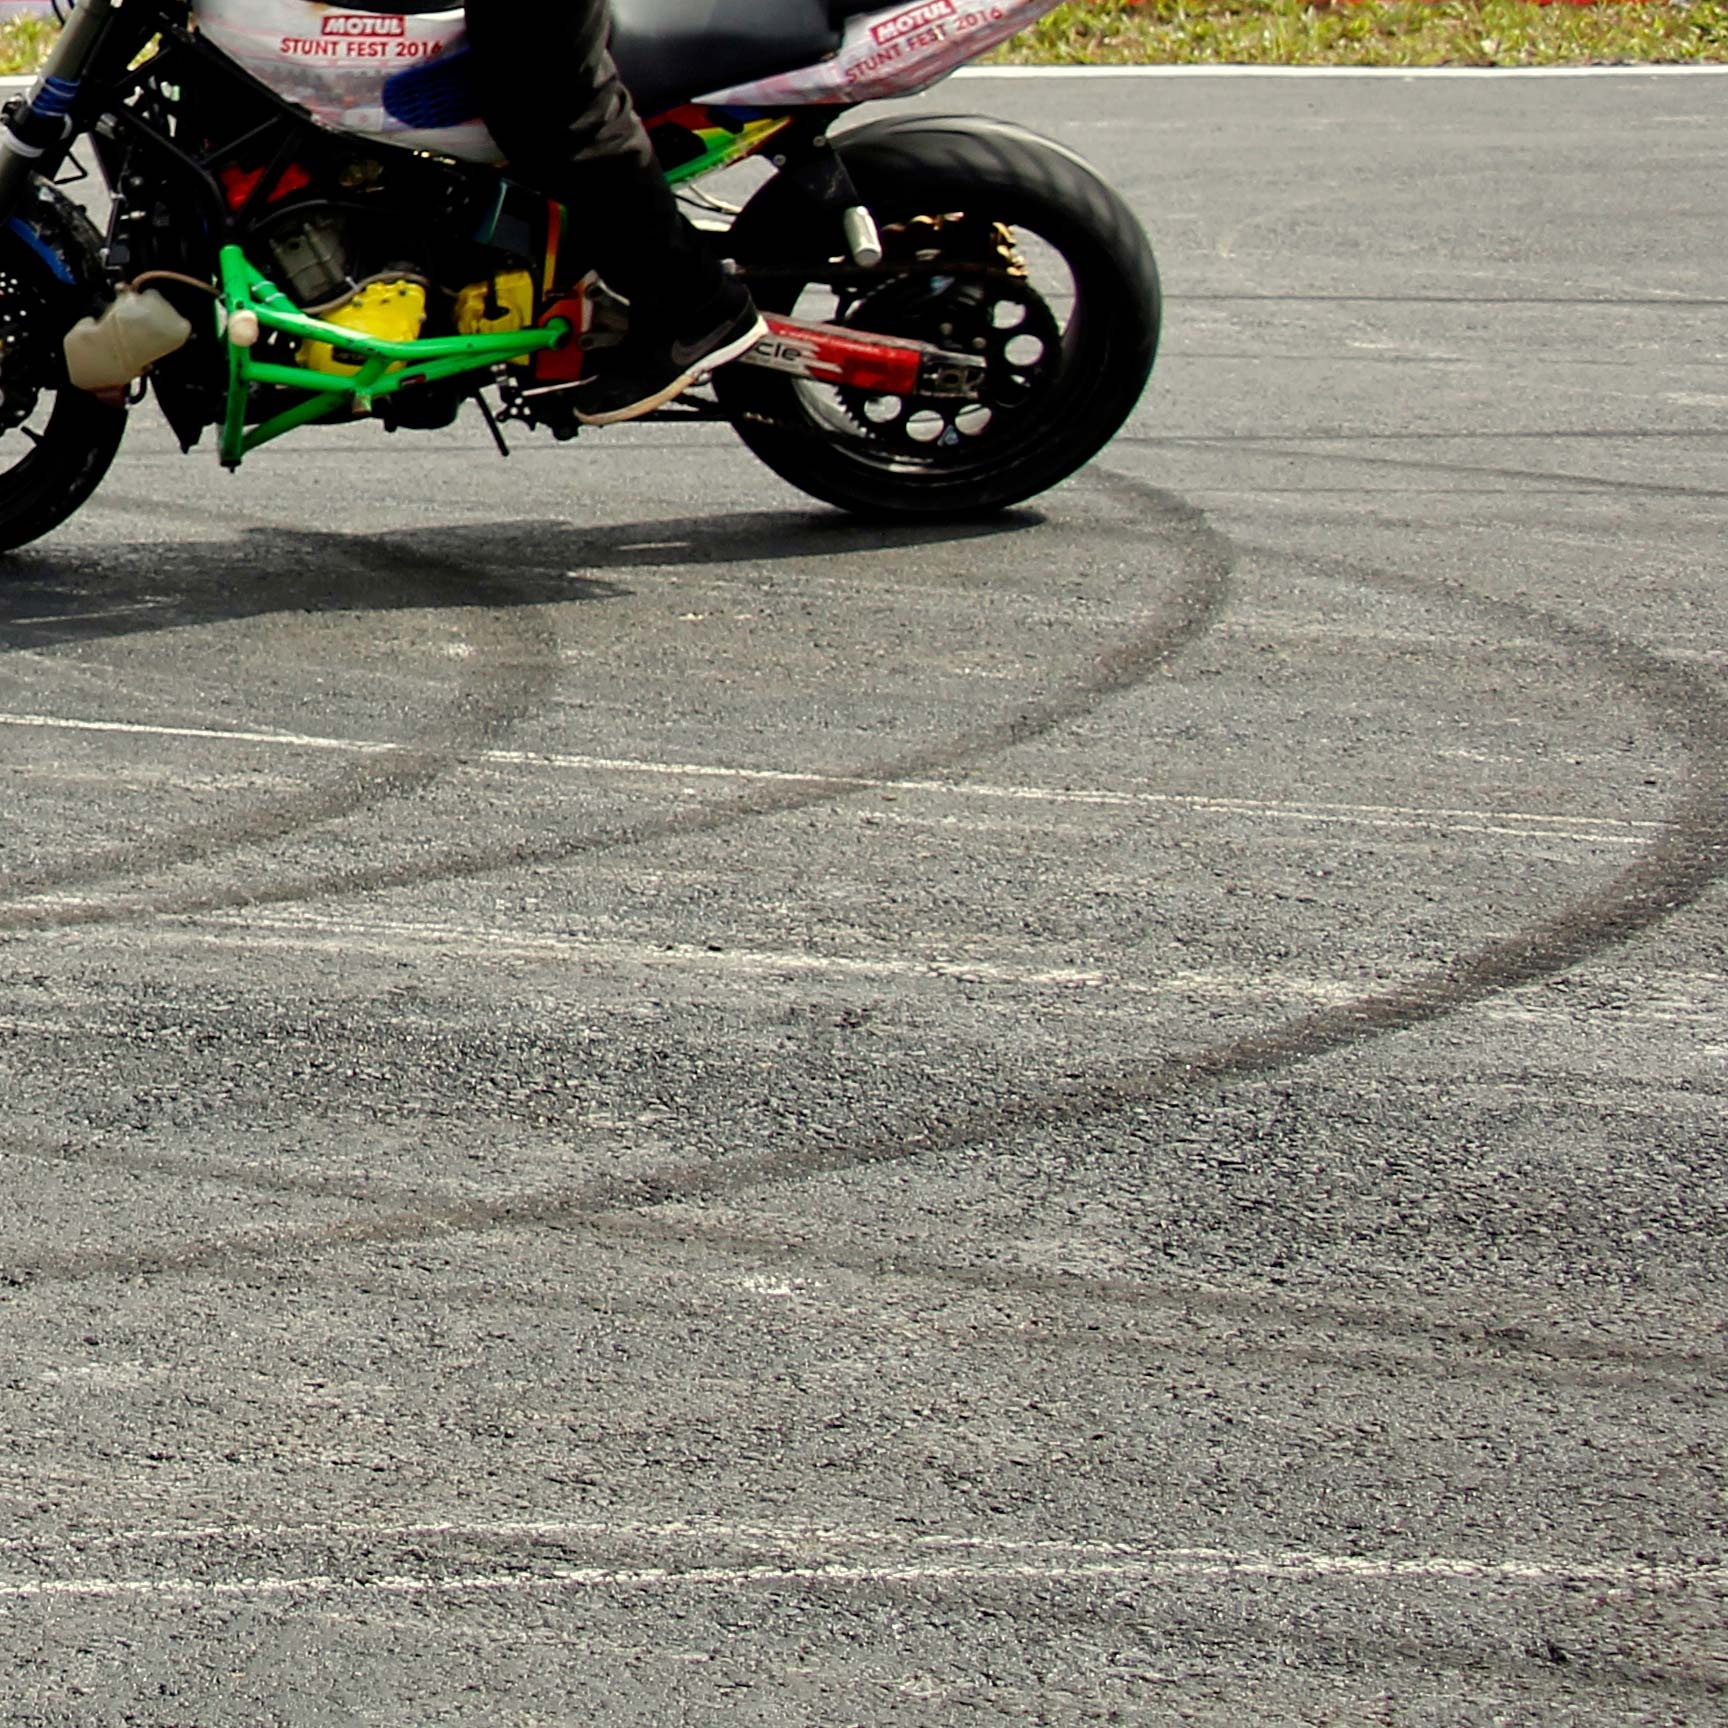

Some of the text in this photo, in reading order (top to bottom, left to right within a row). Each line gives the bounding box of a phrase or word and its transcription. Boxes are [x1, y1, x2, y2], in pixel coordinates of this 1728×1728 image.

[324, 17, 403, 35] MOTUL
[877, 1, 953, 42] MOTUL
[280, 38, 443, 57] STUNT FEST 2016
[844, 43, 901, 84] STUNT
[955, 7, 1003, 31] 2016
